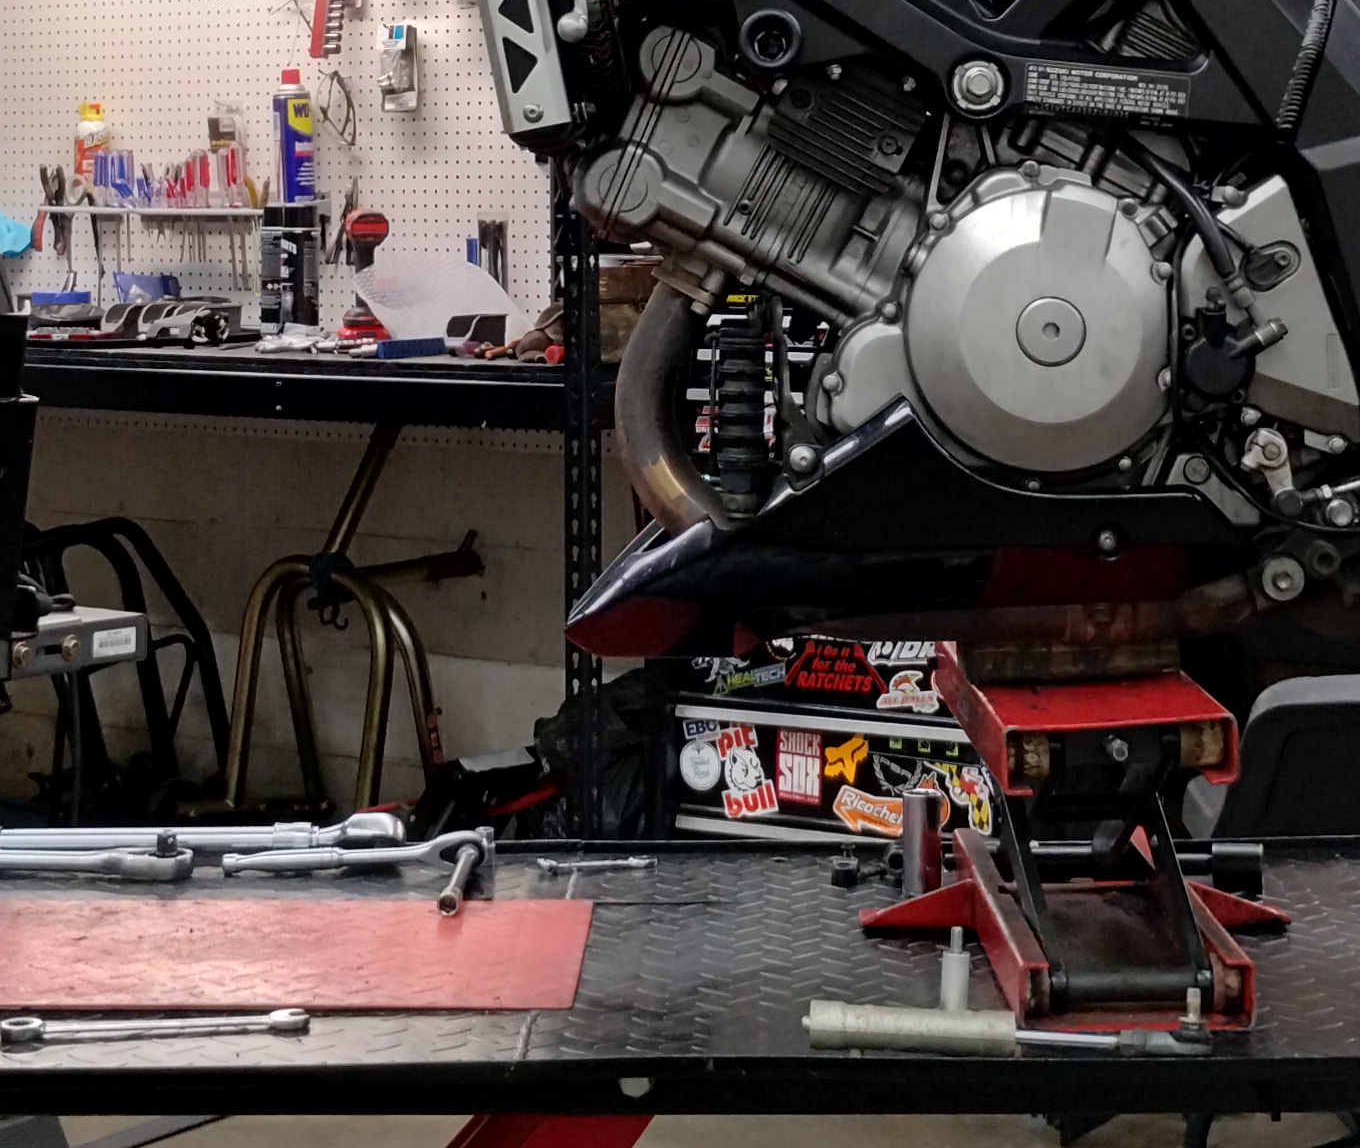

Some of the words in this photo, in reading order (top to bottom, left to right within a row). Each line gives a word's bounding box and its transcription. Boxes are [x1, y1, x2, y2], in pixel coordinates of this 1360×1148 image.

[797, 670, 873, 692] RATCHETS
[685, 720, 717, 736] EBC
[717, 725, 756, 758] pit
[779, 729, 821, 756] SHOCK
[779, 752, 820, 797] SOX
[724, 782, 775, 818] bull
